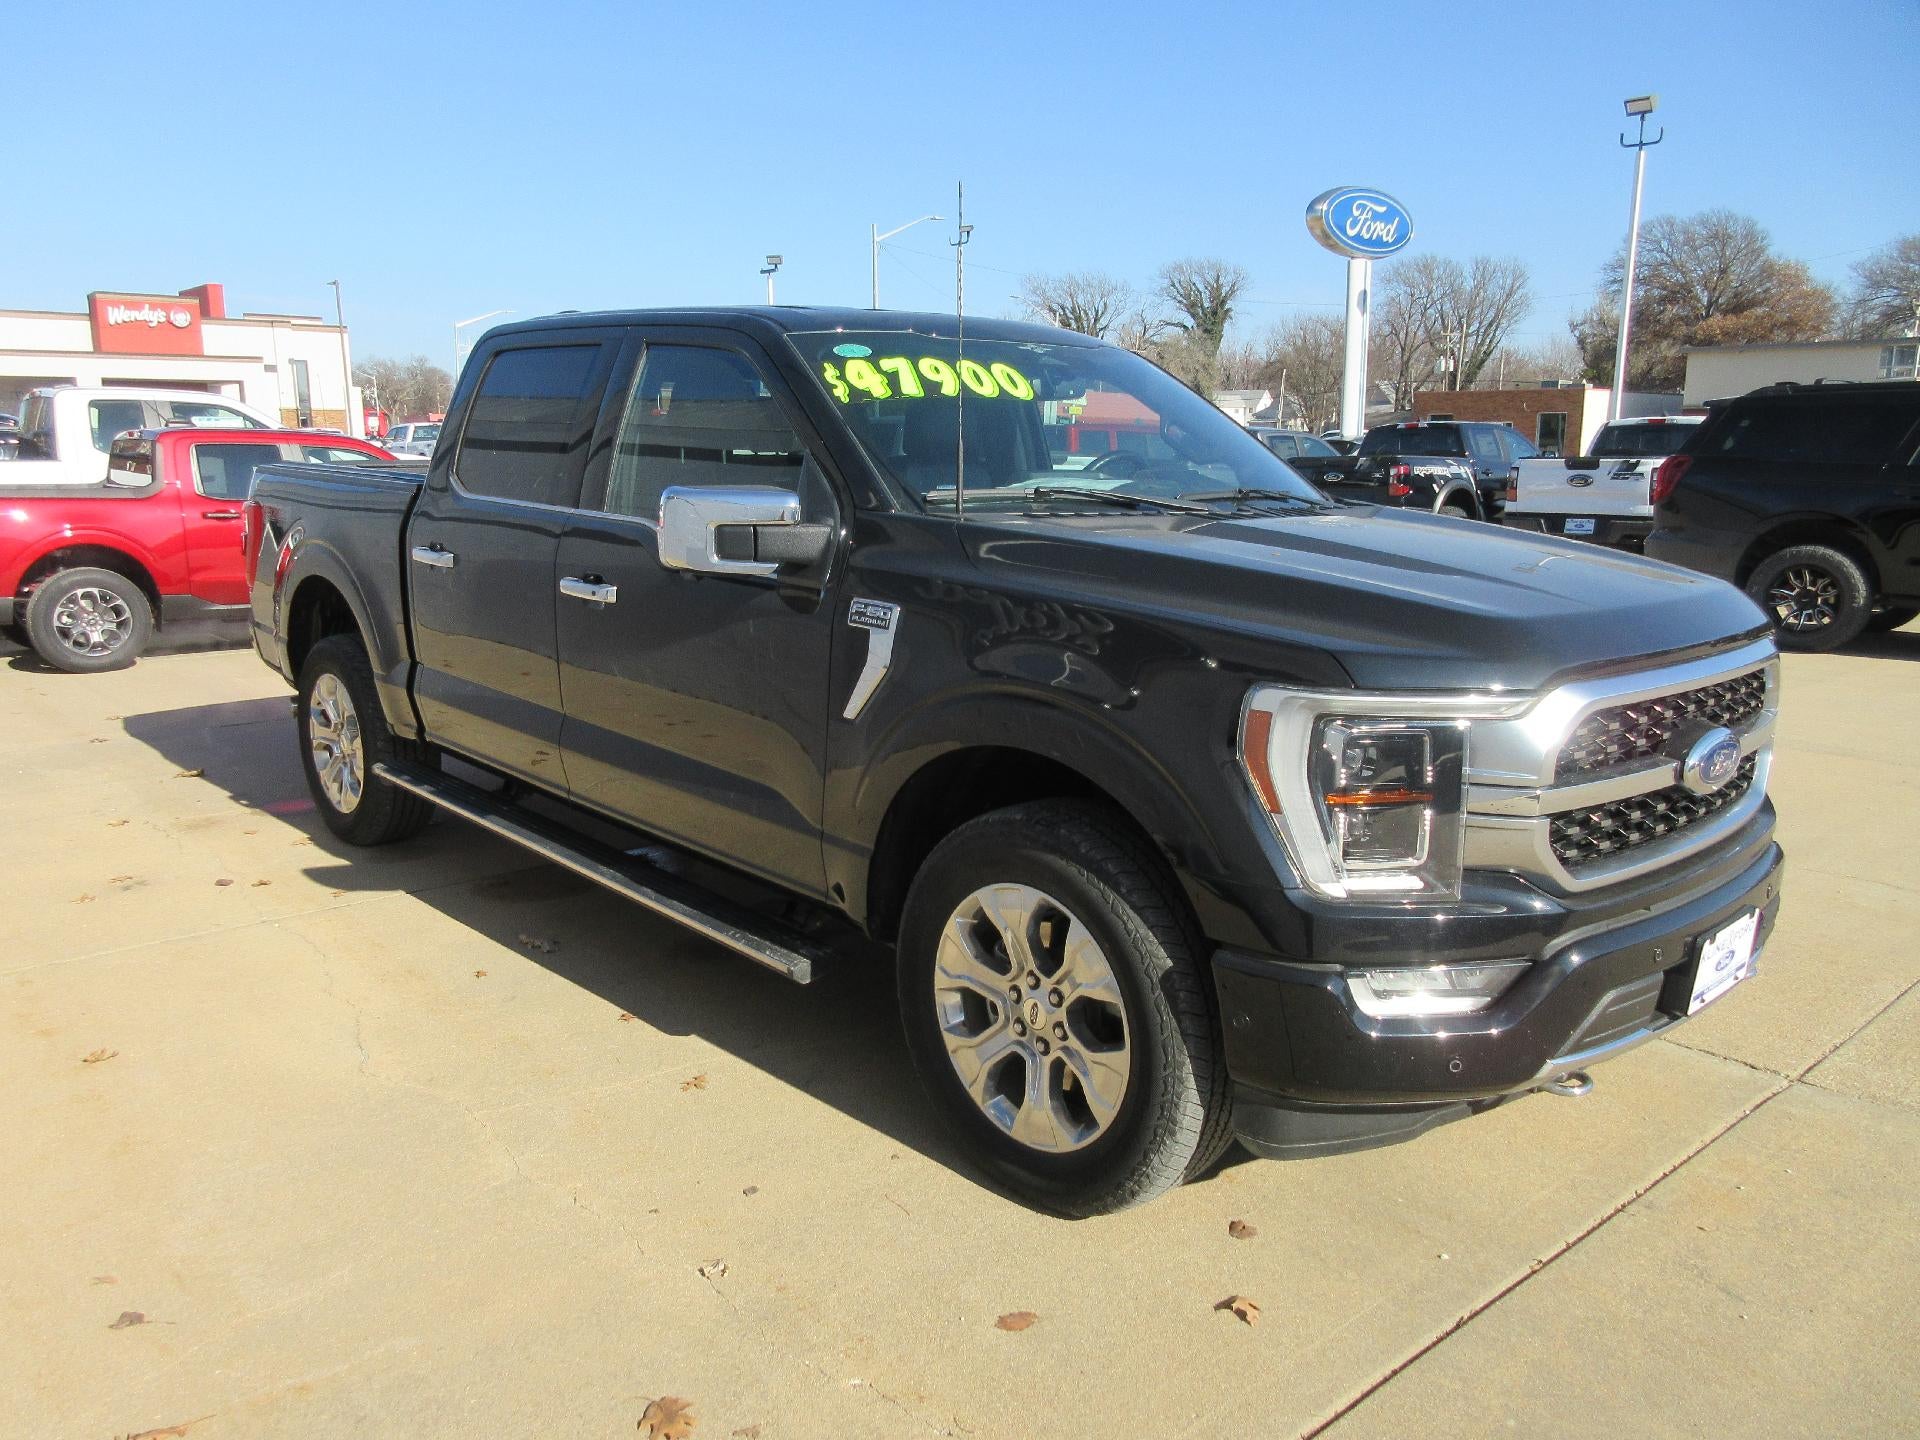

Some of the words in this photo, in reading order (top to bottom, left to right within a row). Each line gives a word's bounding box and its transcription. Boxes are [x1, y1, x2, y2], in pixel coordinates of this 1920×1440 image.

[1346, 200, 1399, 243] Ford
[107, 303, 167, 327] Wendy's
[823, 356, 1035, 404] $47900
[851, 602, 891, 620] F-150
[851, 614, 890, 628] PLATINUM
